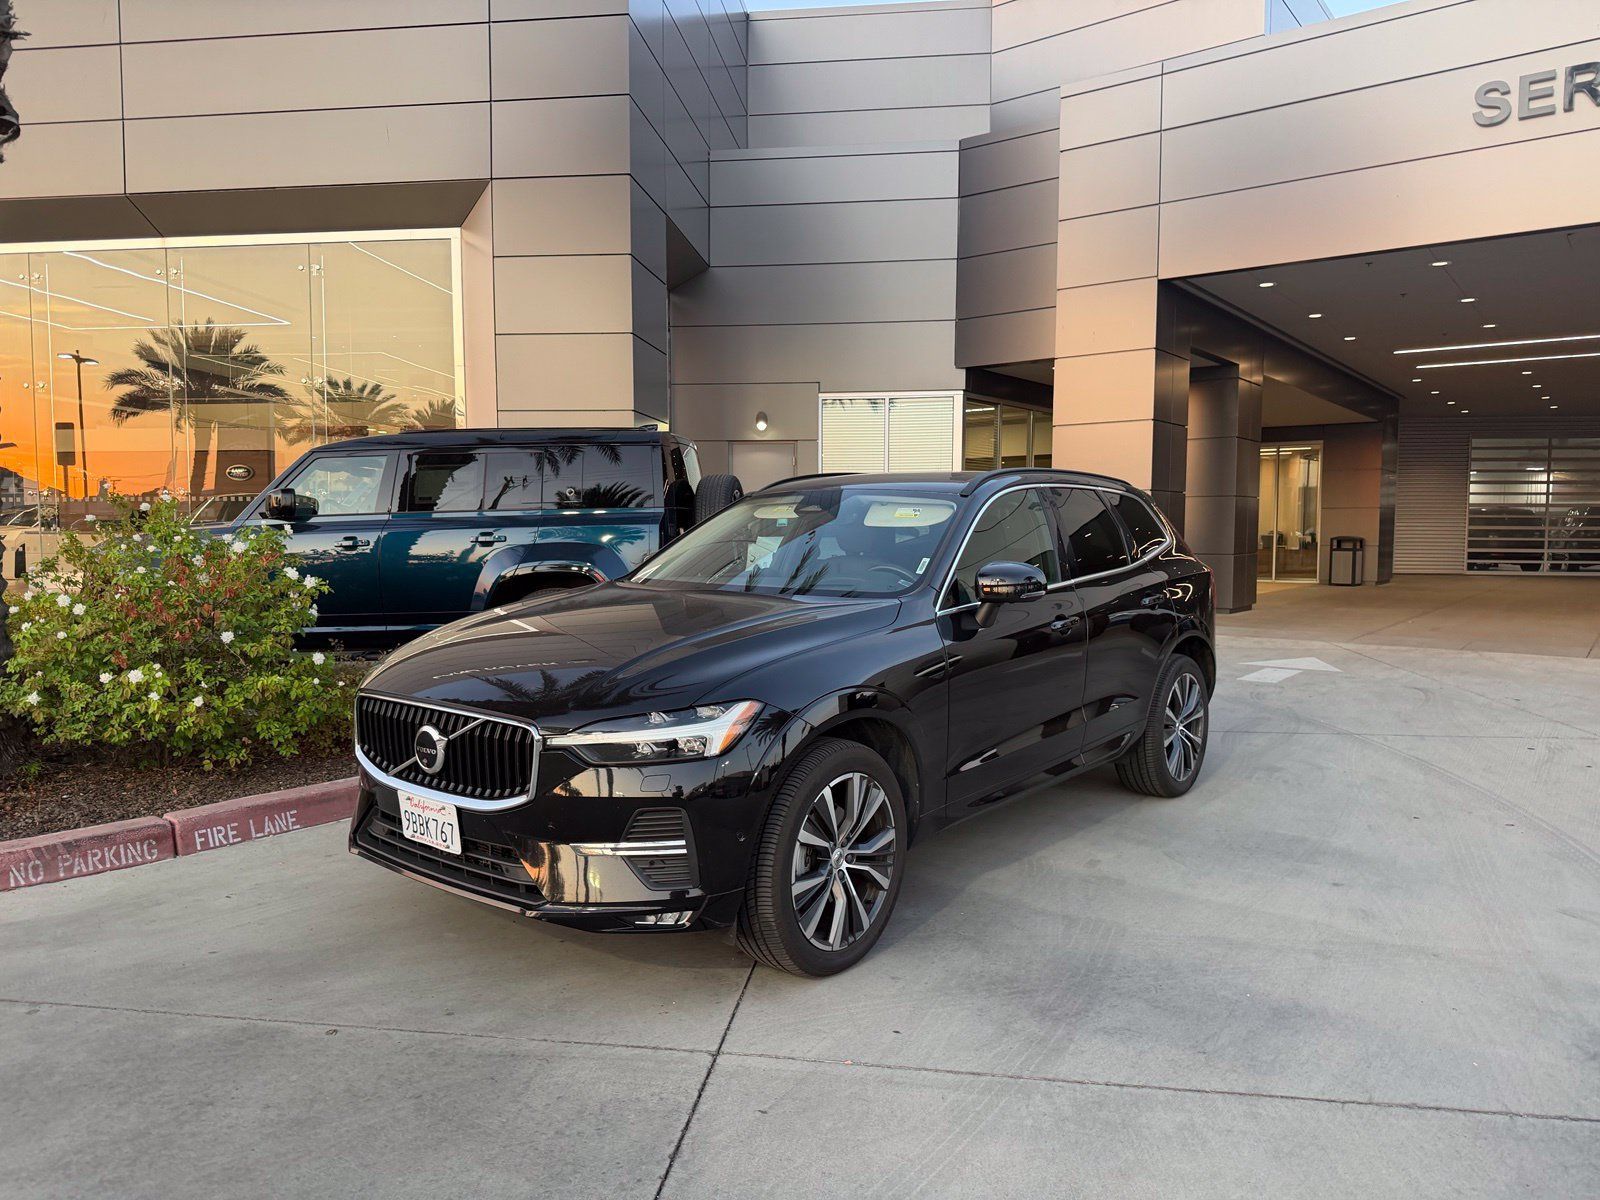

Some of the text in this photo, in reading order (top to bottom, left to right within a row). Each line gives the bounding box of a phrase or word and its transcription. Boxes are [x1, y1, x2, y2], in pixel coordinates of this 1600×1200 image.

[1472, 61, 1600, 128] SER
[416, 745, 437, 755] VOLVO
[194, 809, 300, 851] FIRE LANE
[404, 809, 454, 846] 9BBK767
[8, 839, 158, 887] NO PARKING
